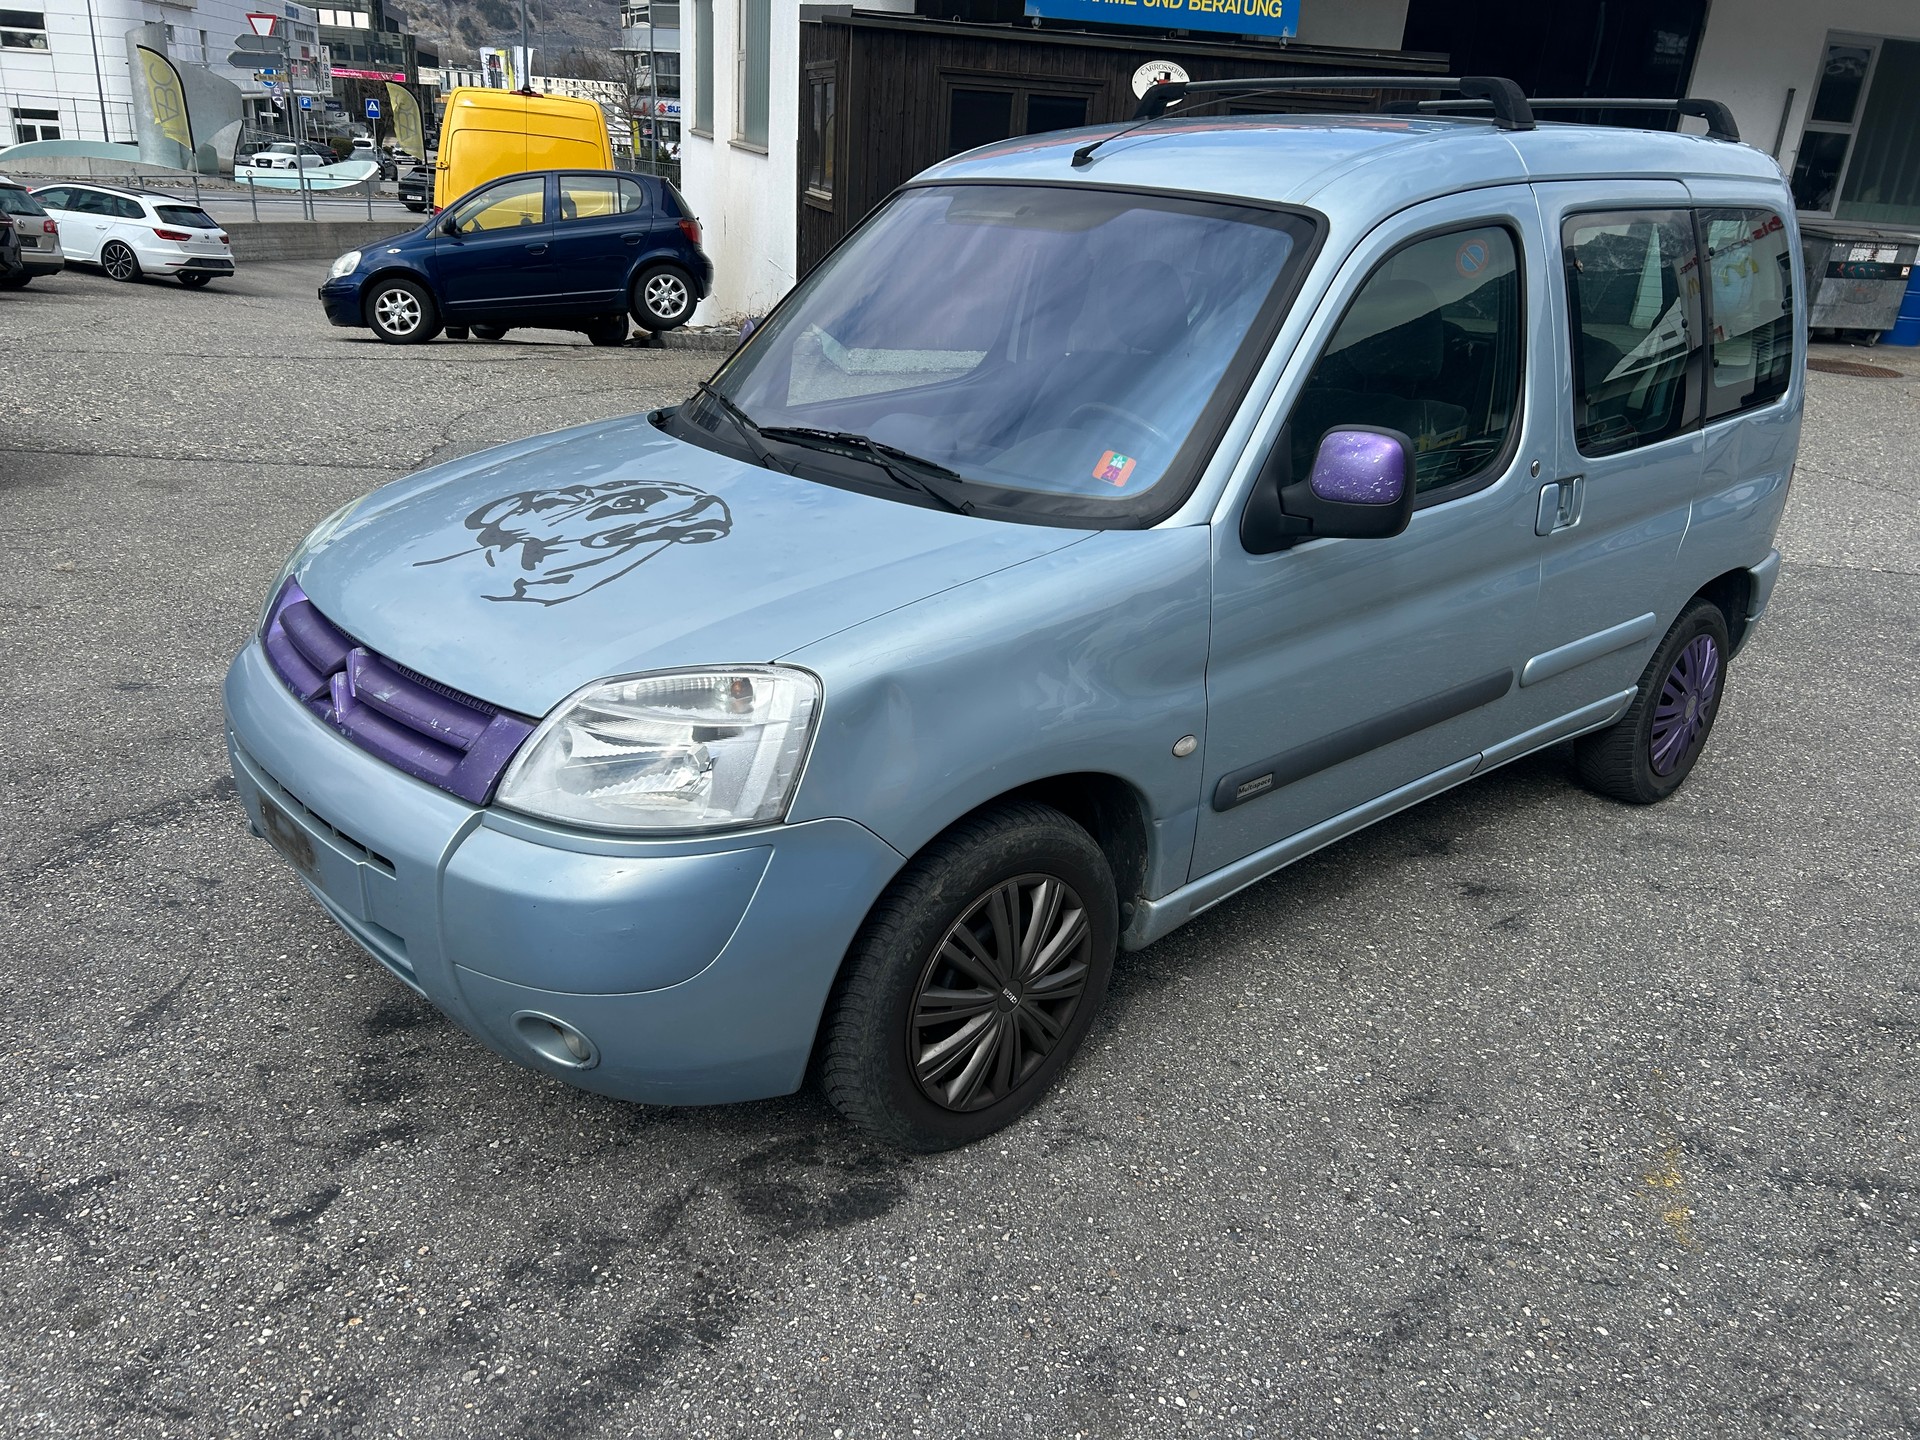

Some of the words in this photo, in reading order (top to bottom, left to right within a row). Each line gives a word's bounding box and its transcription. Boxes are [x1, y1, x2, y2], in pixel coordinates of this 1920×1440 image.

[1188, 0, 1283, 18] BERATUNG
[321, 46, 331, 88] FARBE
[1140, 63, 1186, 80] CARROSSERIE
[1238, 778, 1271, 794] Multispace
